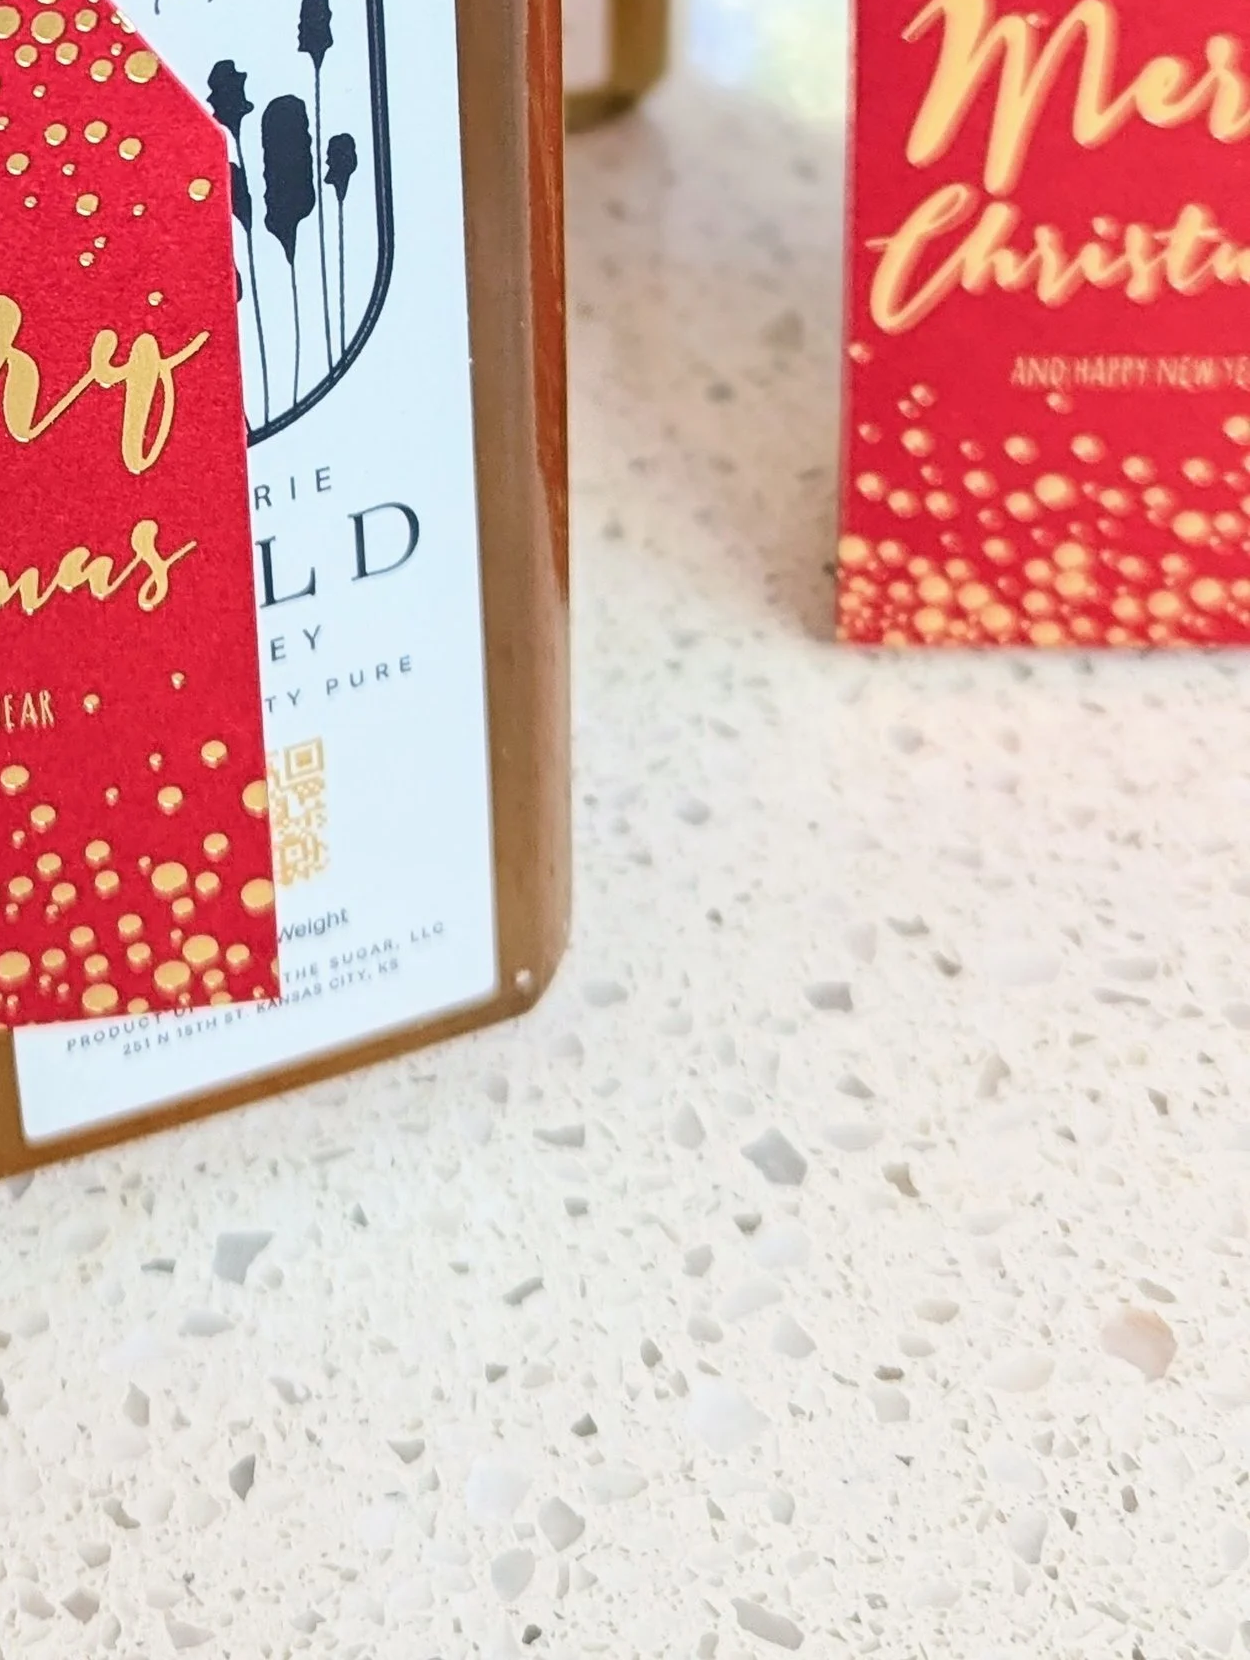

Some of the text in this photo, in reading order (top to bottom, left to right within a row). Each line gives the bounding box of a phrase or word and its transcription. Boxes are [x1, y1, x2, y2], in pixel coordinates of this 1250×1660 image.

[1010, 354, 1069, 388] AND
[1074, 354, 1148, 388] HAPPY
[1156, 354, 1217, 391] NEW
[325, 654, 413, 696] PURE
[65, 1011, 162, 1053] PRODUCT
[283, 961, 320, 985] THE
[409, 920, 445, 944] LLC
[377, 957, 400, 978] KS
